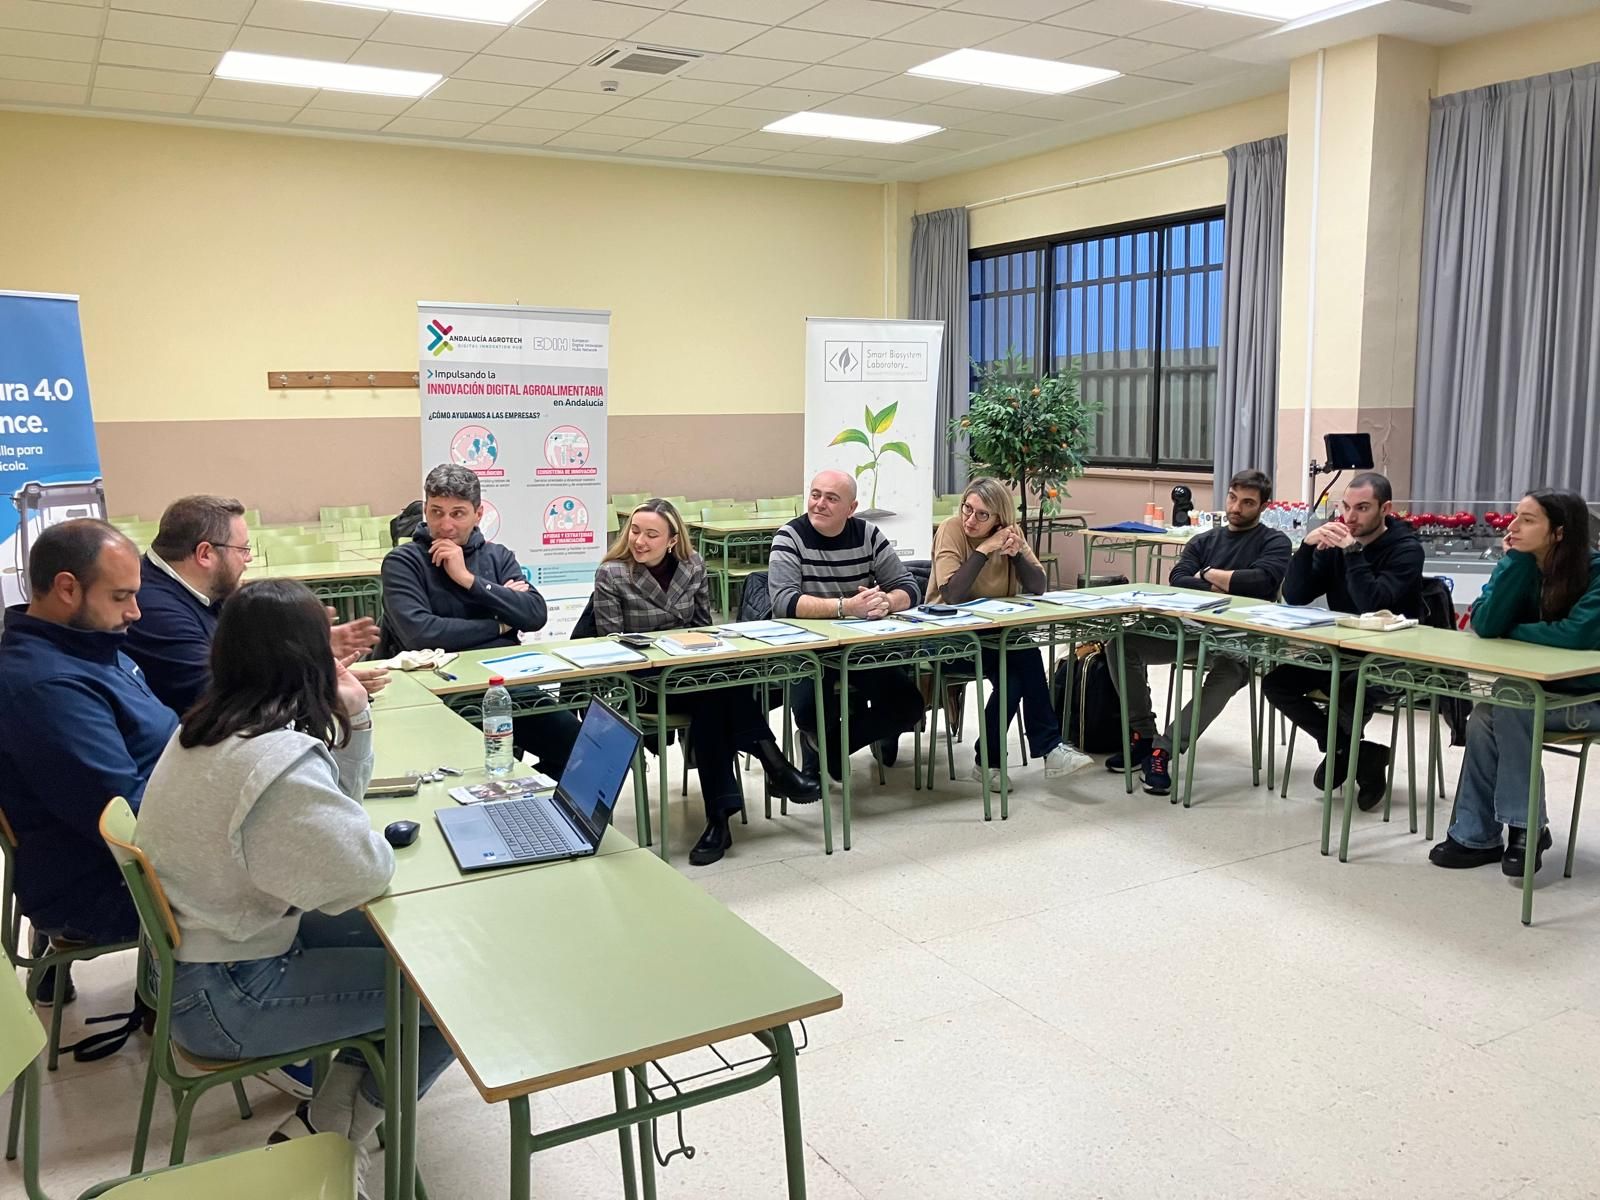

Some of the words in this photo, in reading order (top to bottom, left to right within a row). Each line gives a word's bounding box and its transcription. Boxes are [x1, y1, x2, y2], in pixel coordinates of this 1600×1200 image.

[449, 334, 487, 343] ANDALUCÍA
[533, 336, 568, 352] EDIH
[867, 349, 887, 358] Smart
[890, 349, 922, 360] Biosystem
[435, 369, 486, 381] Impulsando
[487, 369, 496, 379] la
[33, 378, 73, 401] 4.0
[427, 381, 485, 395] INNOVACIÓN
[486, 384, 521, 395] DIGITAL
[523, 385, 604, 396] AGROALIMENTARIA
[565, 398, 604, 407] Andalucía
[428, 410, 451, 420] ¿CÓMO
[452, 411, 485, 419] AYUDAMOS
[16, 446, 43, 457] para
